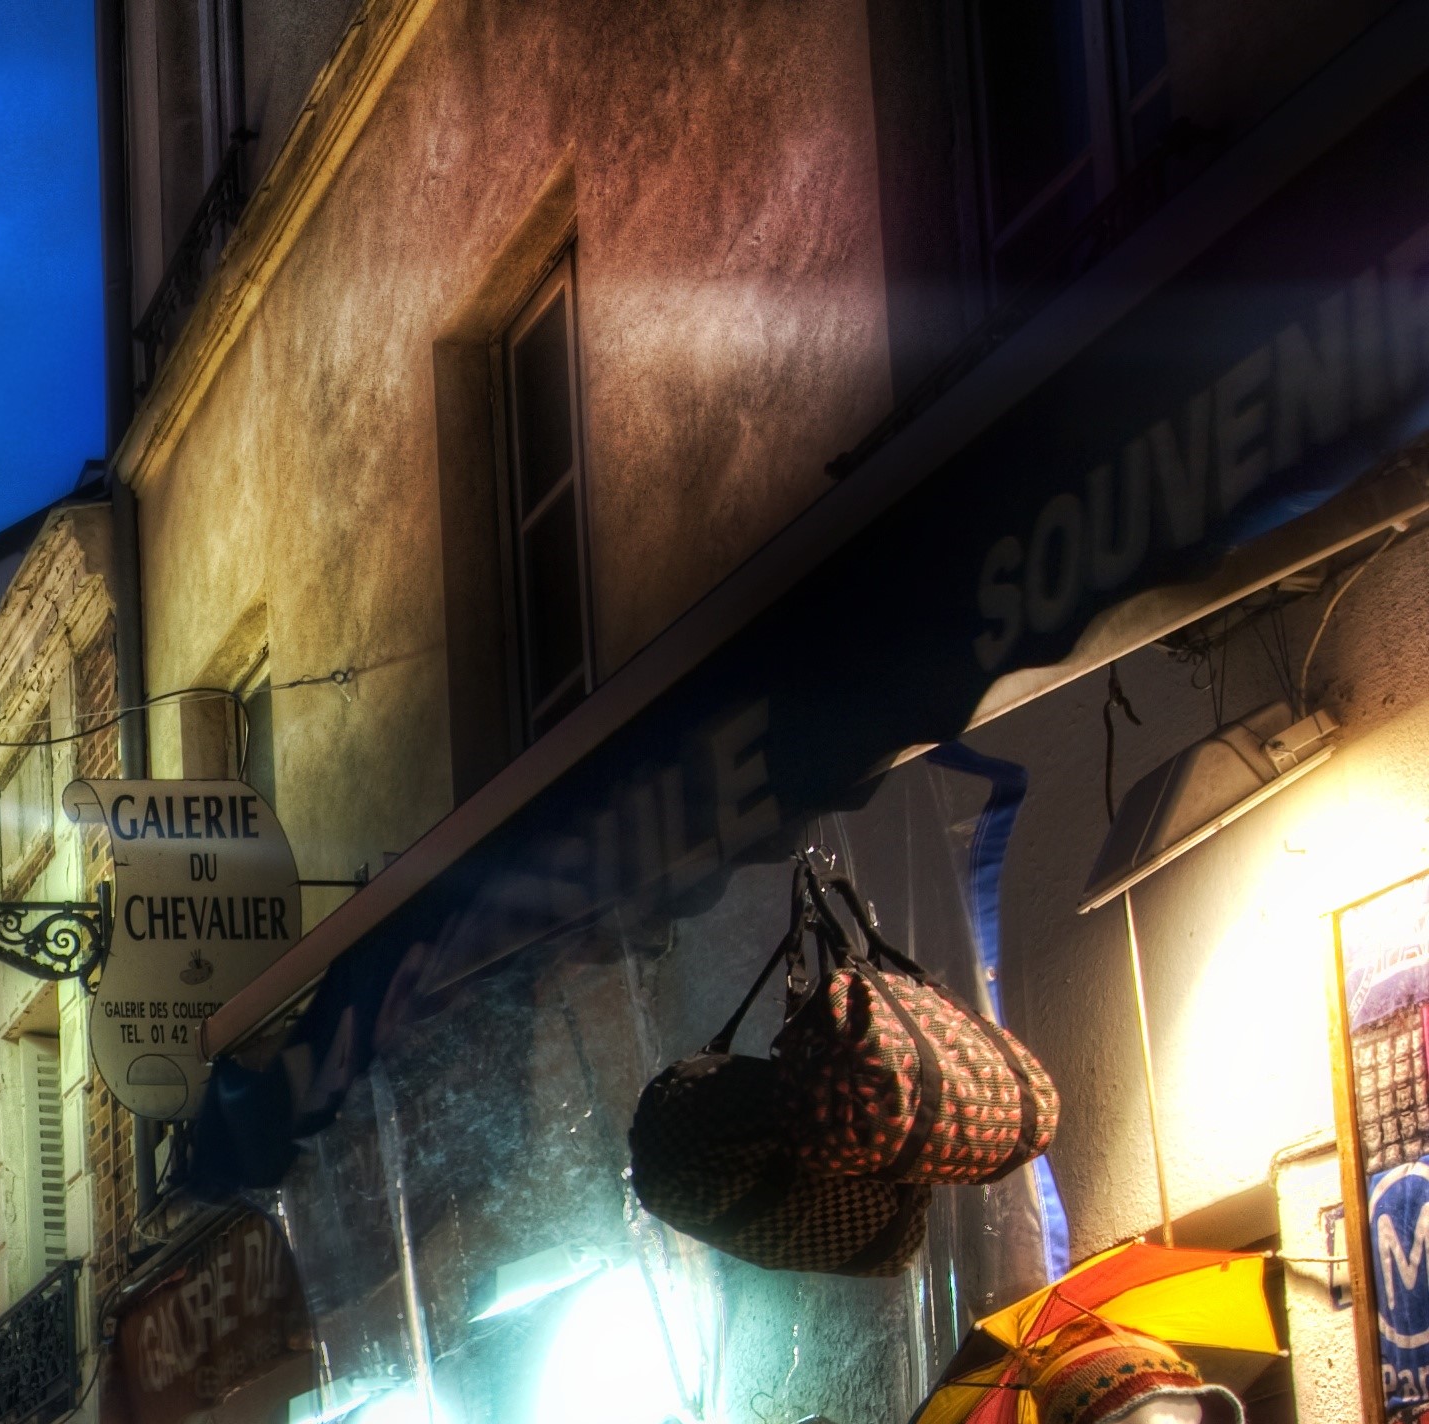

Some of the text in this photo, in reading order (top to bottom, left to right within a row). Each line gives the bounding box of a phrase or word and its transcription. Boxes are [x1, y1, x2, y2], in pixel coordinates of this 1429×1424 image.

[111, 794, 260, 840] GALERIE
[190, 853, 217, 882] DU
[125, 895, 289, 941] CHEVALIER
[150, 1001, 169, 1020] DES
[151, 1024, 165, 1044] 01
[171, 1024, 189, 1044] 42
